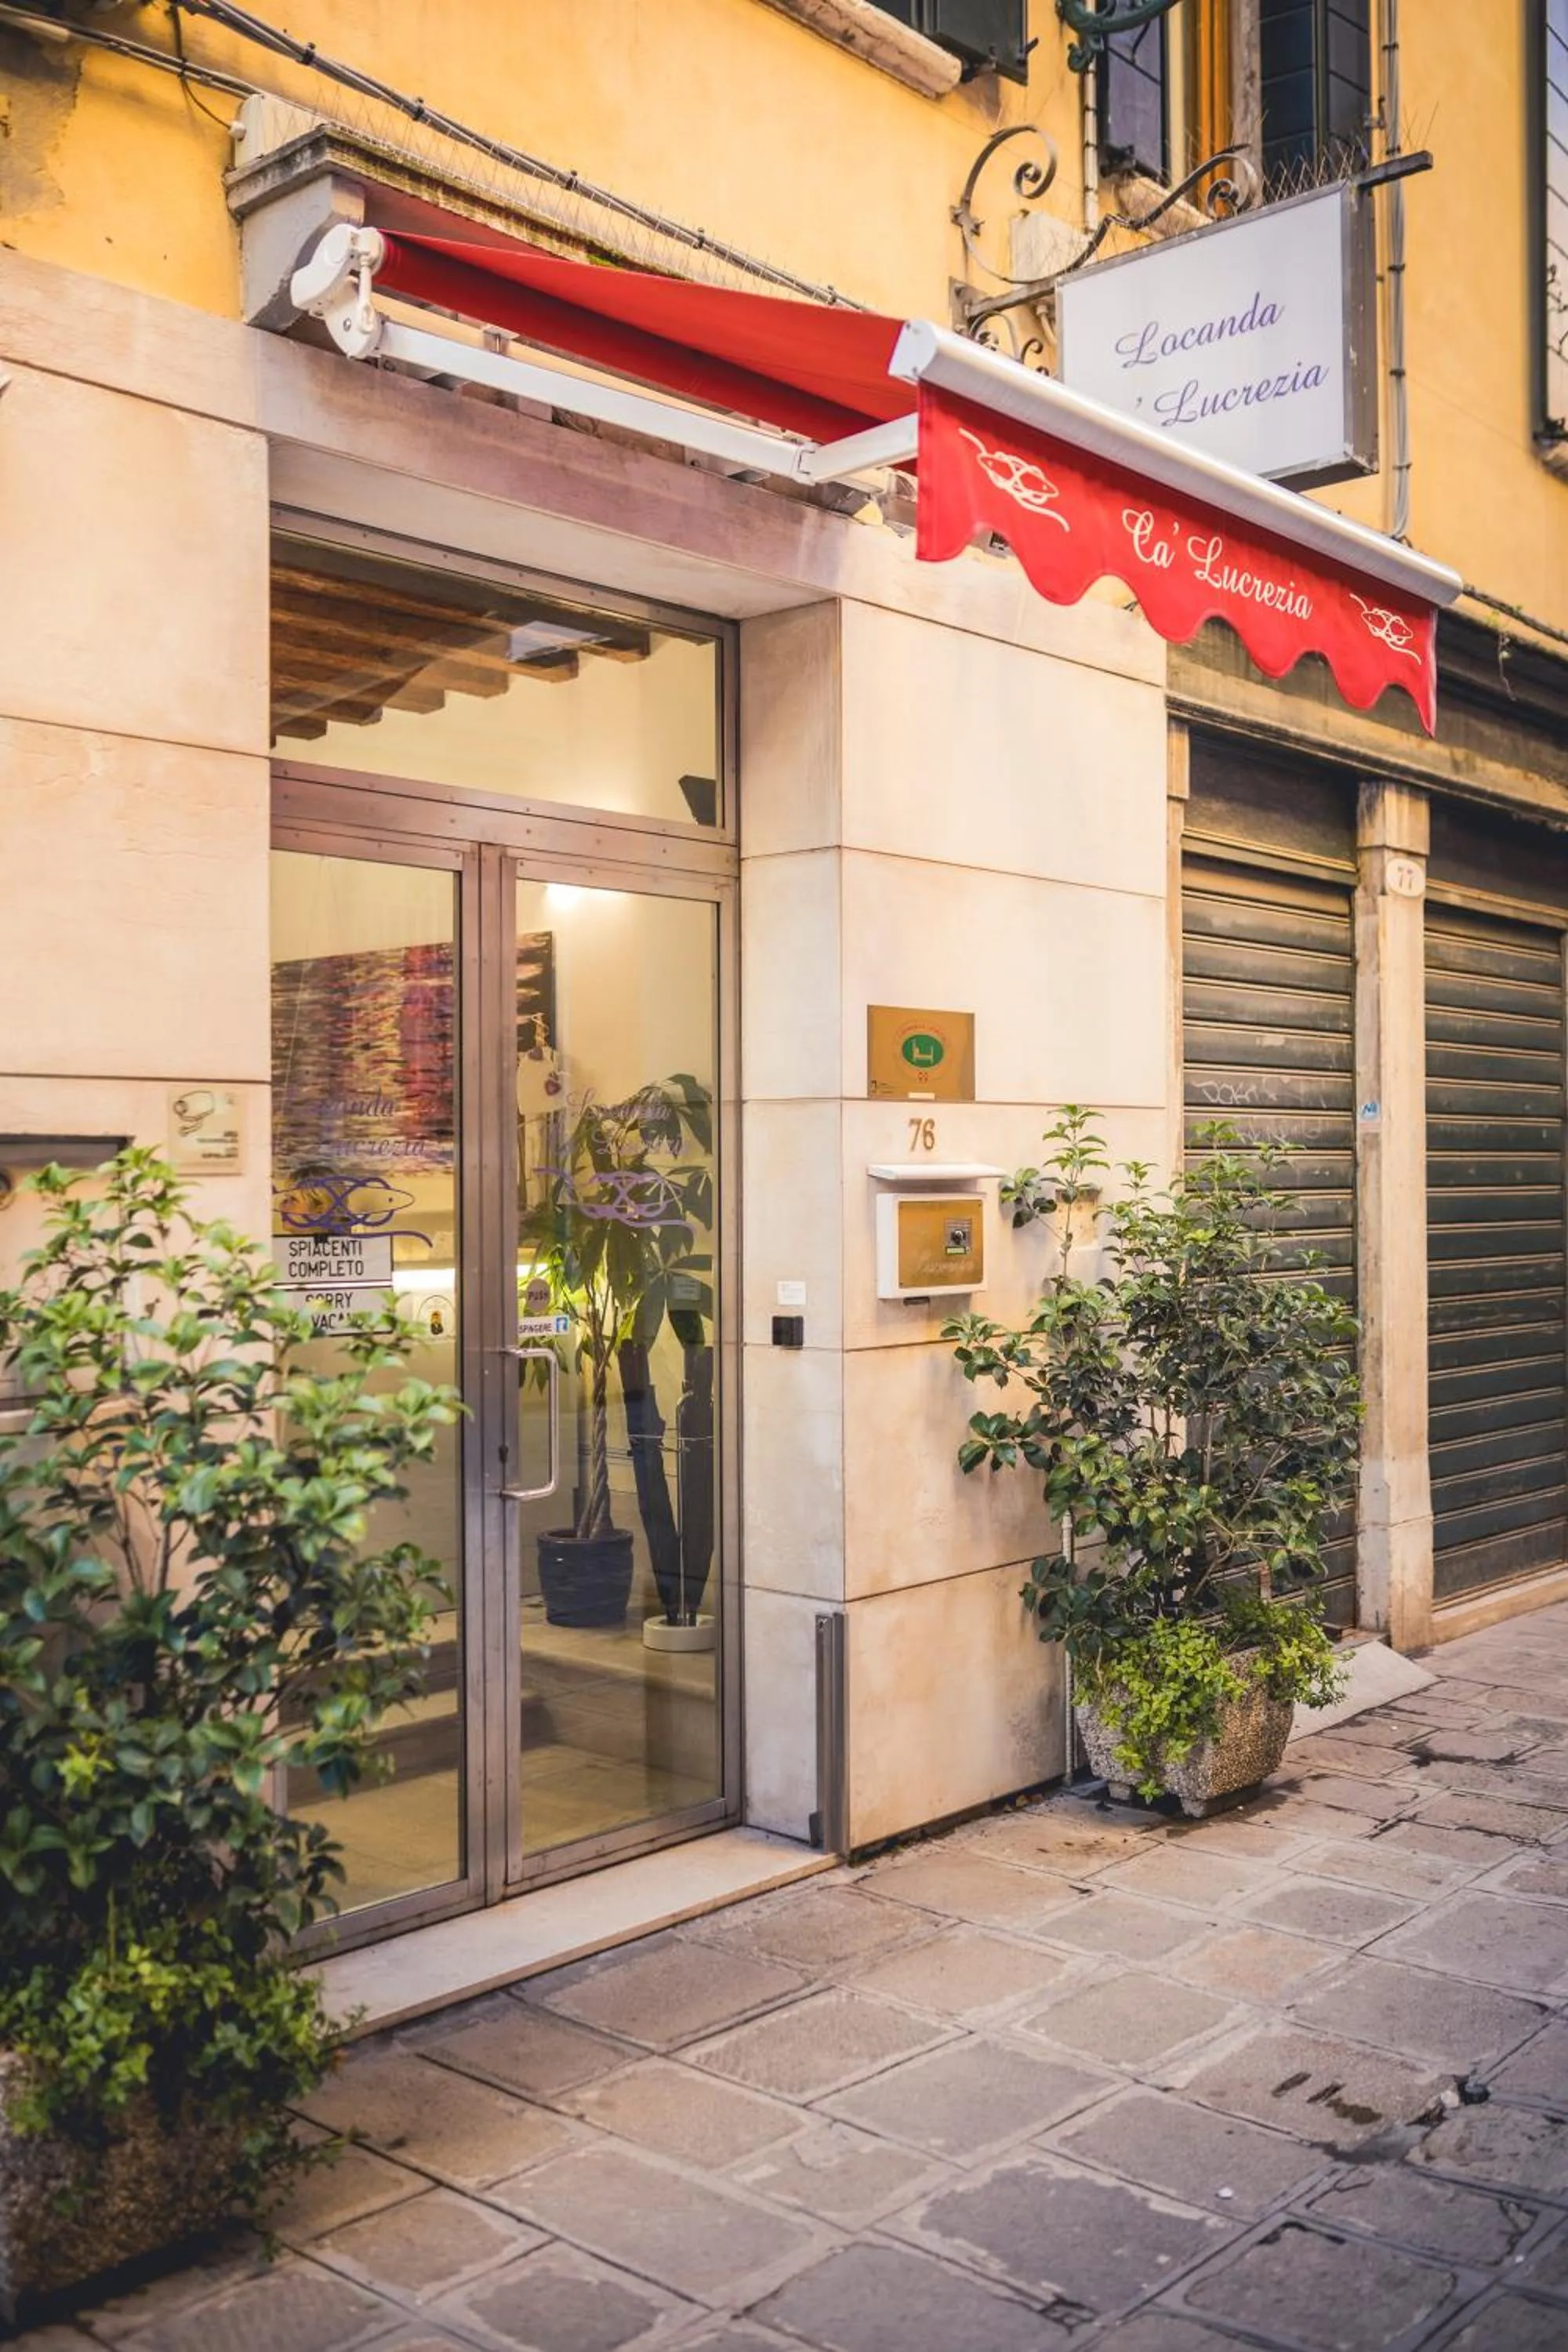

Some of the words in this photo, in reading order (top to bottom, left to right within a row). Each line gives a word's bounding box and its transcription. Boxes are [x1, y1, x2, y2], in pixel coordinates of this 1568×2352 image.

[1115, 291, 1285, 368] Locanda
[1121, 509, 1181, 569] Ca'
[1187, 537, 1313, 620] Lucrezia
[908, 1118, 936, 1152] 76
[288, 1240, 362, 1258] SPIACENTI
[288, 1260, 365, 1278] COMPLETO
